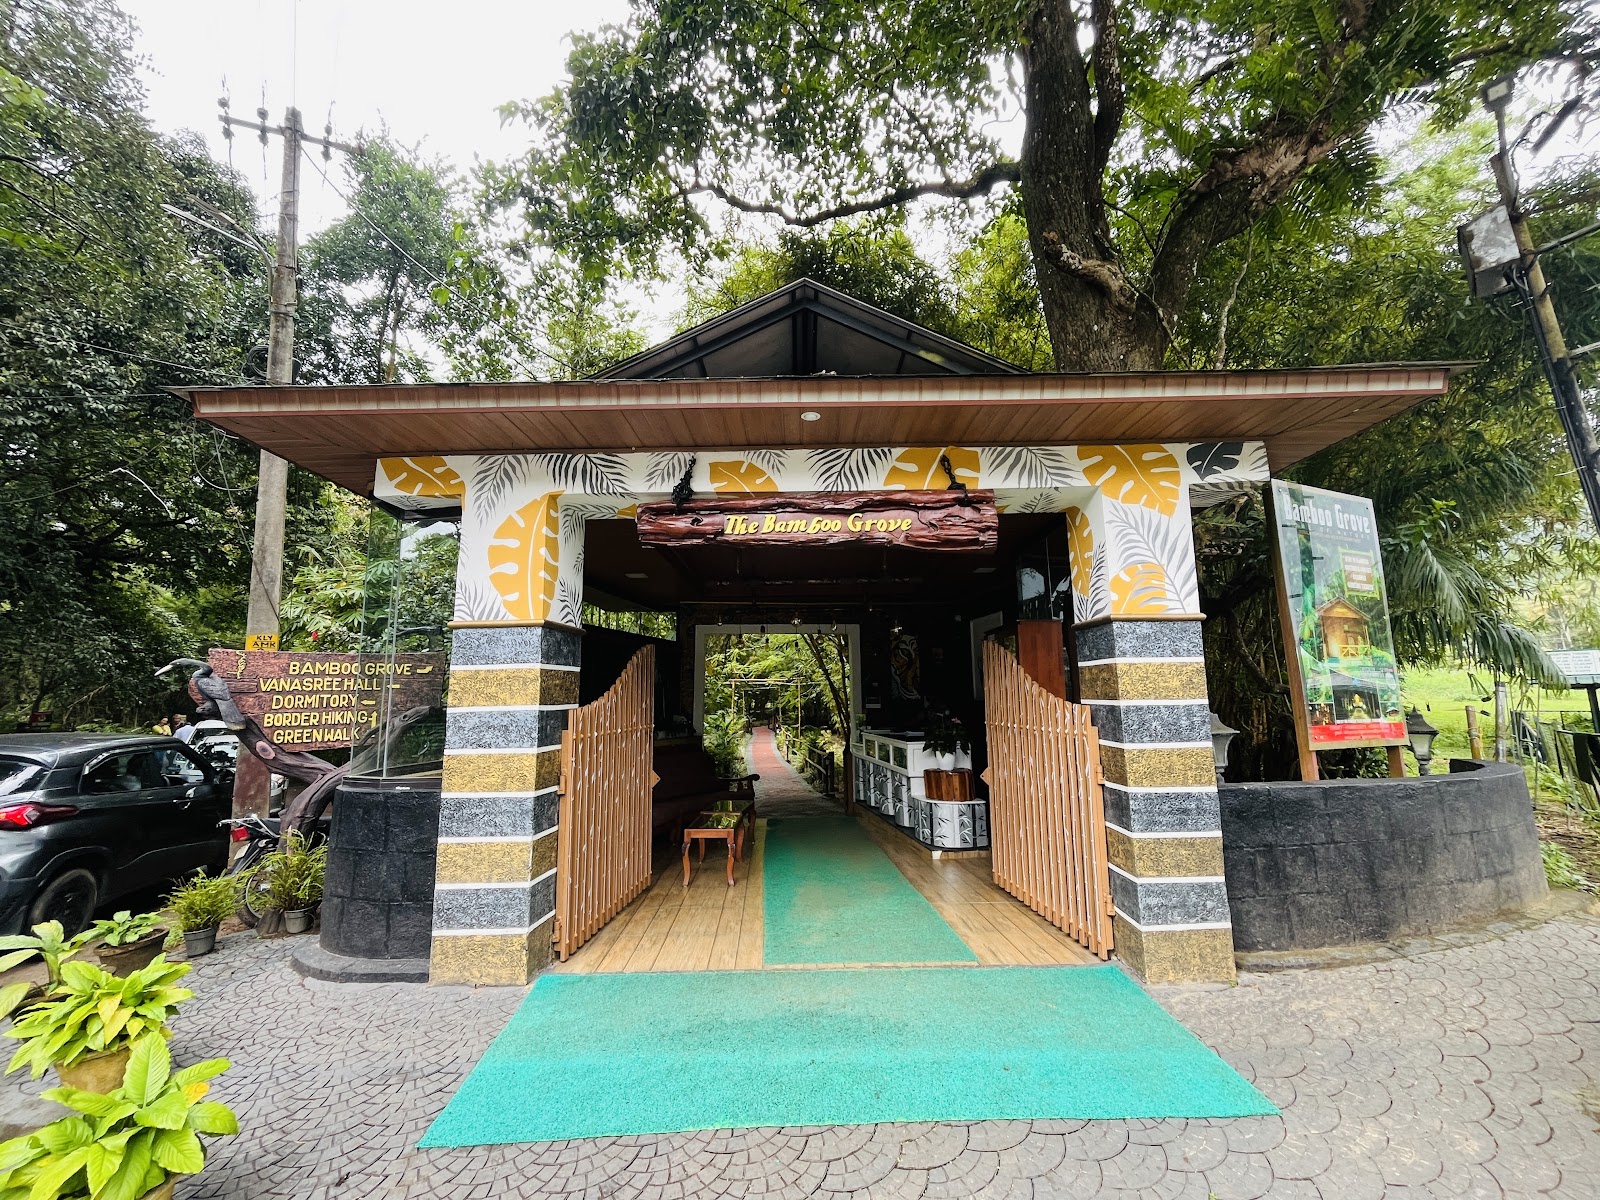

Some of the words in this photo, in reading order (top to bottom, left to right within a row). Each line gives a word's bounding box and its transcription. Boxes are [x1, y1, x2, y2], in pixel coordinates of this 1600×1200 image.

[1283, 494, 1333, 527] Bamboo
[1334, 503, 1371, 534] Grove
[724, 514, 758, 535] The
[760, 513, 842, 534] Bamboo
[847, 512, 912, 533] Grove
[288, 661, 361, 675] BAMBOO
[364, 662, 413, 675] GROVE
[259, 676, 342, 692] VANASREE
[343, 677, 381, 691] HALL
[271, 693, 359, 710] DORMITORY
[263, 712, 320, 728] BORDER
[321, 710, 368, 725] HIKING
